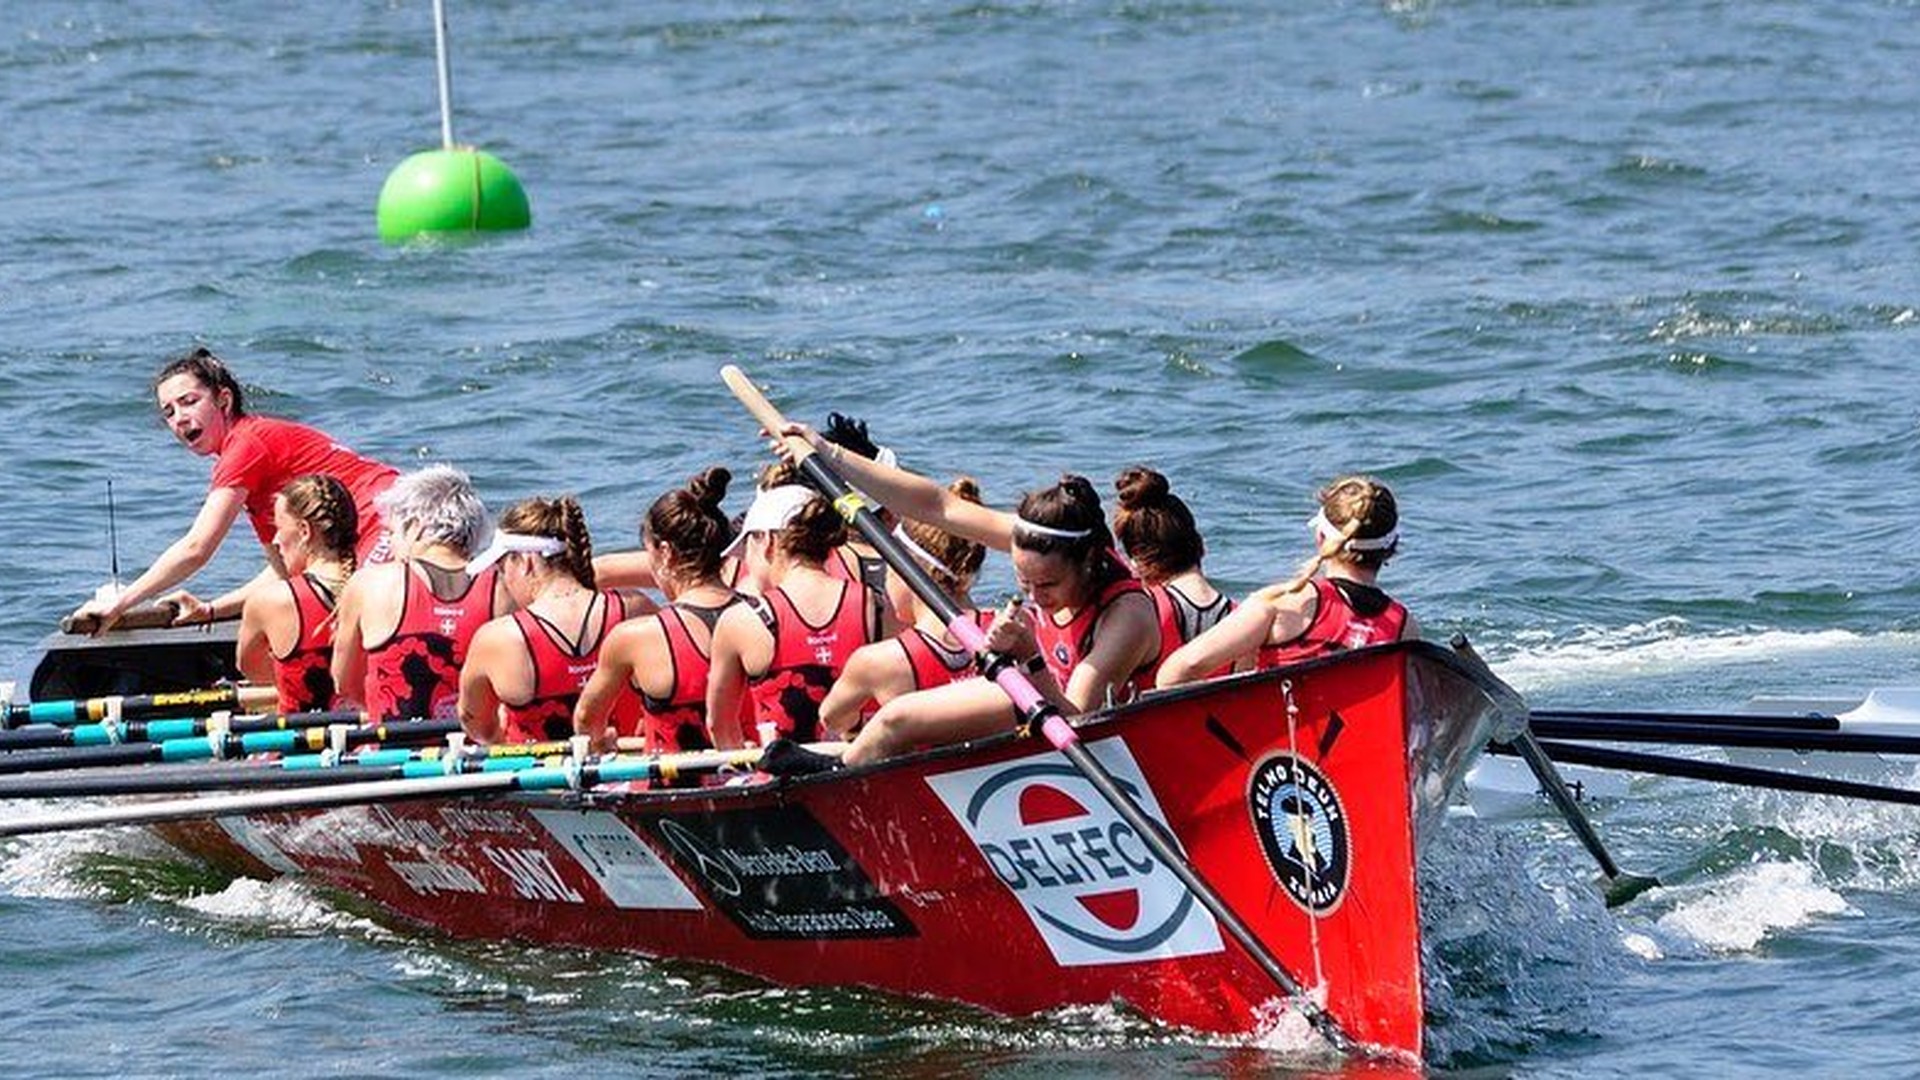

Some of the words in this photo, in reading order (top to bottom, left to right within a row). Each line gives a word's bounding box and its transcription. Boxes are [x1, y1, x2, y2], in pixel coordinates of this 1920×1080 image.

[1256, 765, 1287, 820] TELMO
[481, 846, 585, 903] SANZ
[979, 821, 1154, 891] DELTEC
